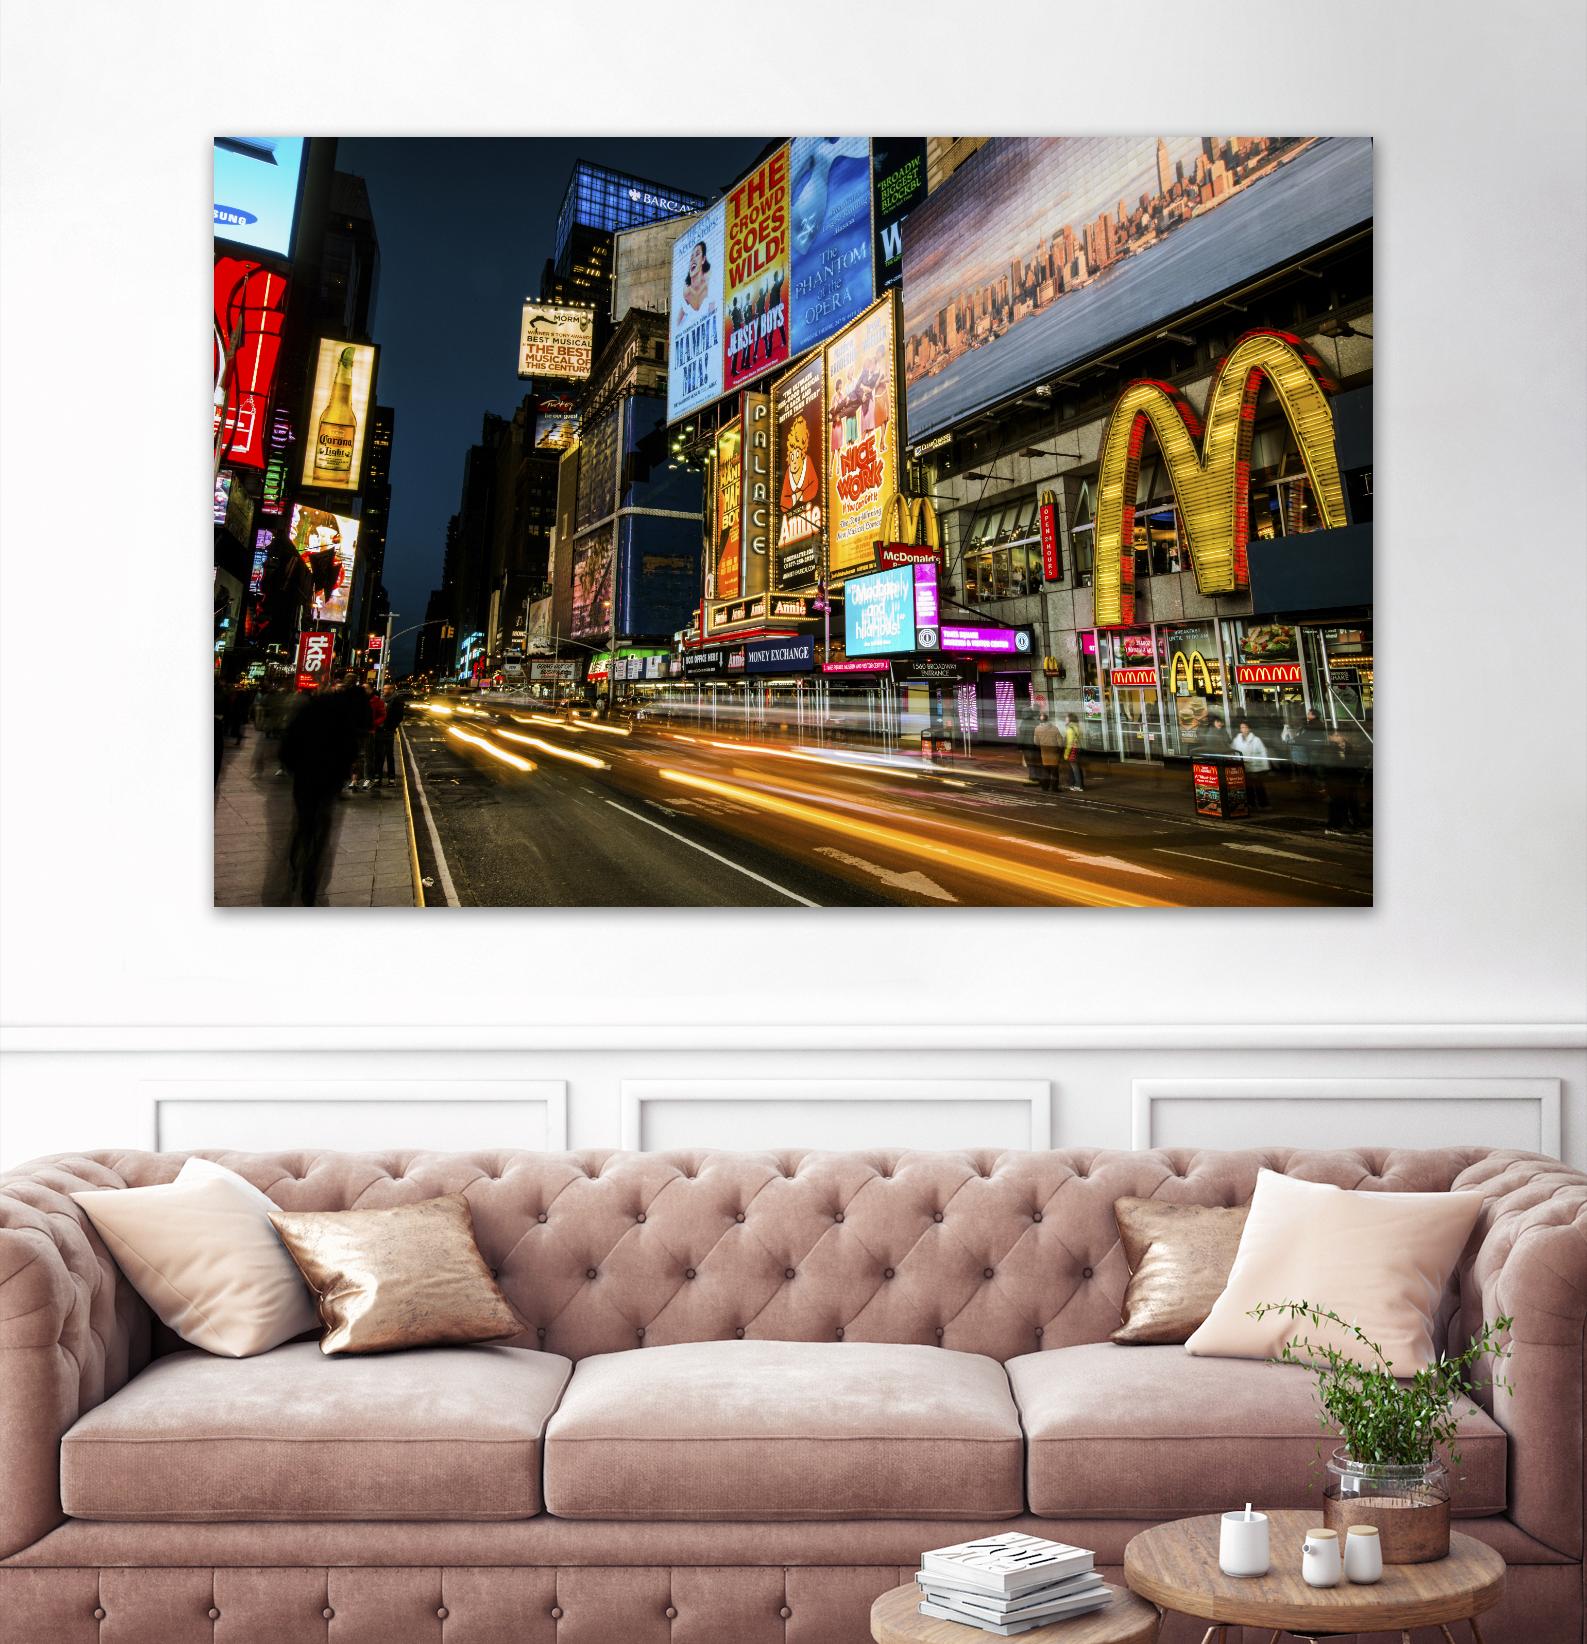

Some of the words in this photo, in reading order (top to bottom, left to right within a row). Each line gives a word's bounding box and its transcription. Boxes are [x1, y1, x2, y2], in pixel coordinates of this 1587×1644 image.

[730, 151, 785, 220] THE
[214, 209, 246, 225] SUNG
[730, 186, 785, 240] CROWD
[729, 205, 785, 264] GOES
[729, 228, 785, 289] WILD!
[795, 241, 867, 300] PHANTOM
[820, 247, 838, 264] The
[805, 287, 852, 325] OPERA
[527, 335, 550, 343] BEST
[553, 338, 593, 347] MUSICAL
[674, 314, 719, 371] MAMMA
[727, 318, 759, 358] JERSEY
[760, 303, 785, 338] BOYS
[525, 354, 574, 365] MUSICAL
[577, 358, 591, 366] OF
[525, 362, 547, 370] THIS
[548, 363, 591, 374] CENTURY
[557, 345, 592, 358] BEST
[682, 352, 709, 397] MIA!
[319, 433, 352, 447] Corona
[325, 446, 345, 457] Light
[841, 434, 876, 478] NICE
[753, 404, 767, 555] PALACE
[836, 458, 884, 502] WORK
[778, 502, 822, 547] Annie
[1043, 508, 1051, 535] OPEN
[883, 550, 941, 565] McDonald's
[1045, 543, 1054, 576] HOURS
[774, 598, 807, 616] Annie
[304, 635, 329, 672] tkts
[748, 650, 770, 663] MONEY
[771, 646, 810, 662] EXCHANGE
[921, 669, 950, 677] ENTRANCE
